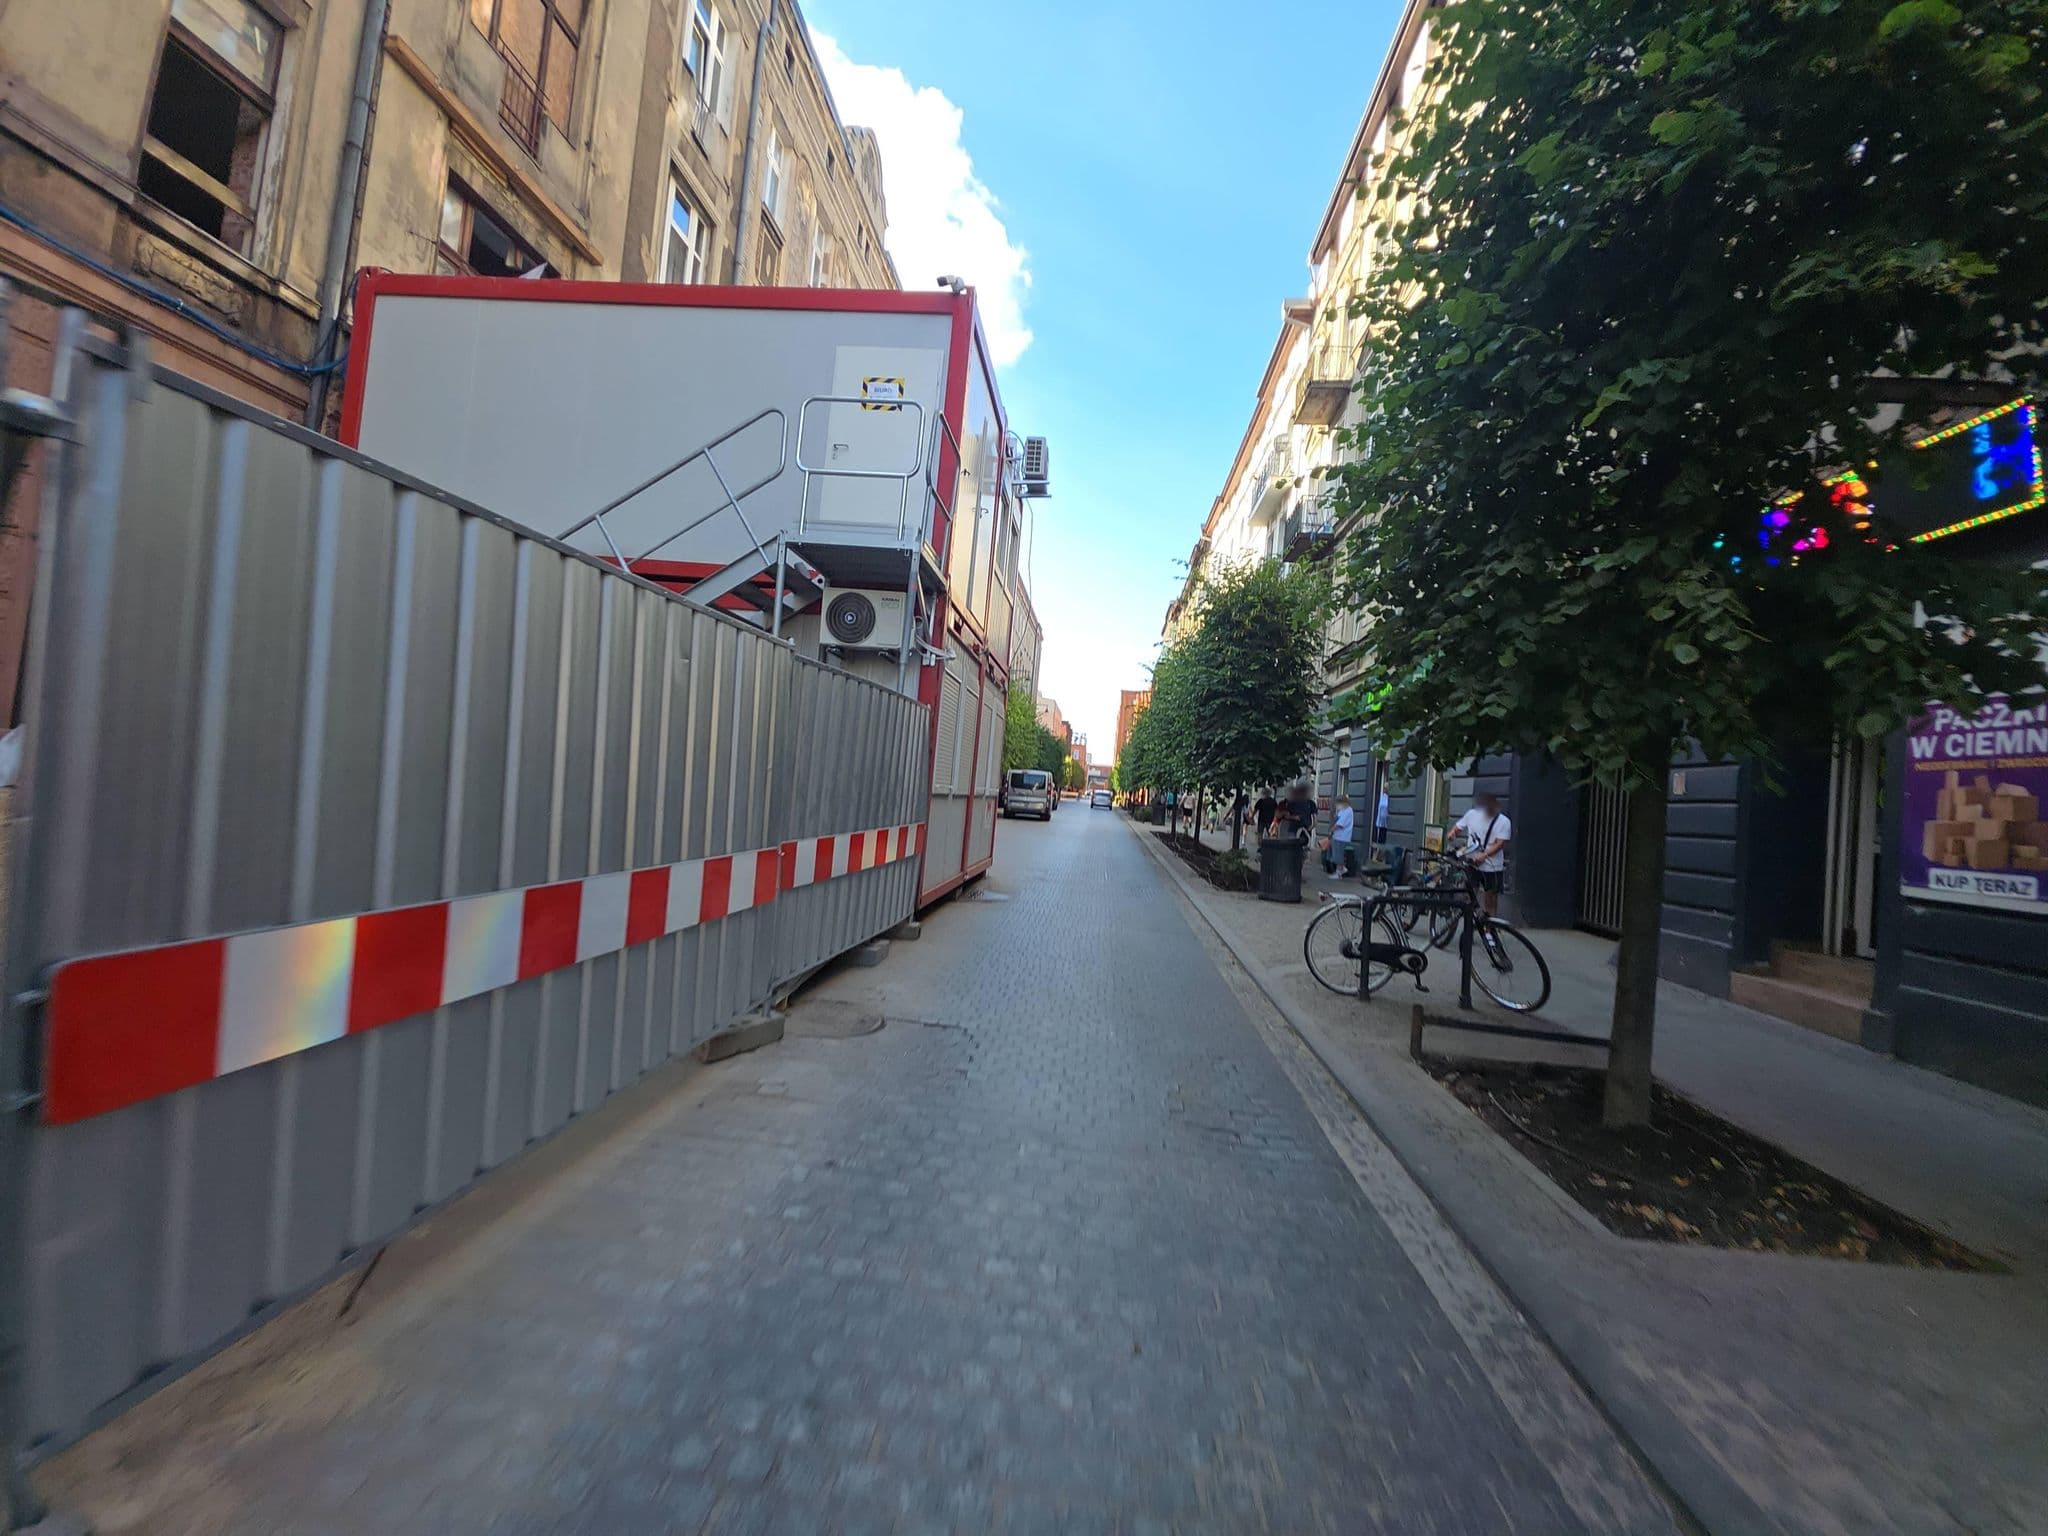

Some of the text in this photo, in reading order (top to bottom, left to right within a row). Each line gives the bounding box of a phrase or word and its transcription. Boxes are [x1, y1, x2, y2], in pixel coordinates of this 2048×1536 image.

[1911, 727, 2048, 759] W CIEMN
[1935, 873, 2032, 896] KUP TERAZ
